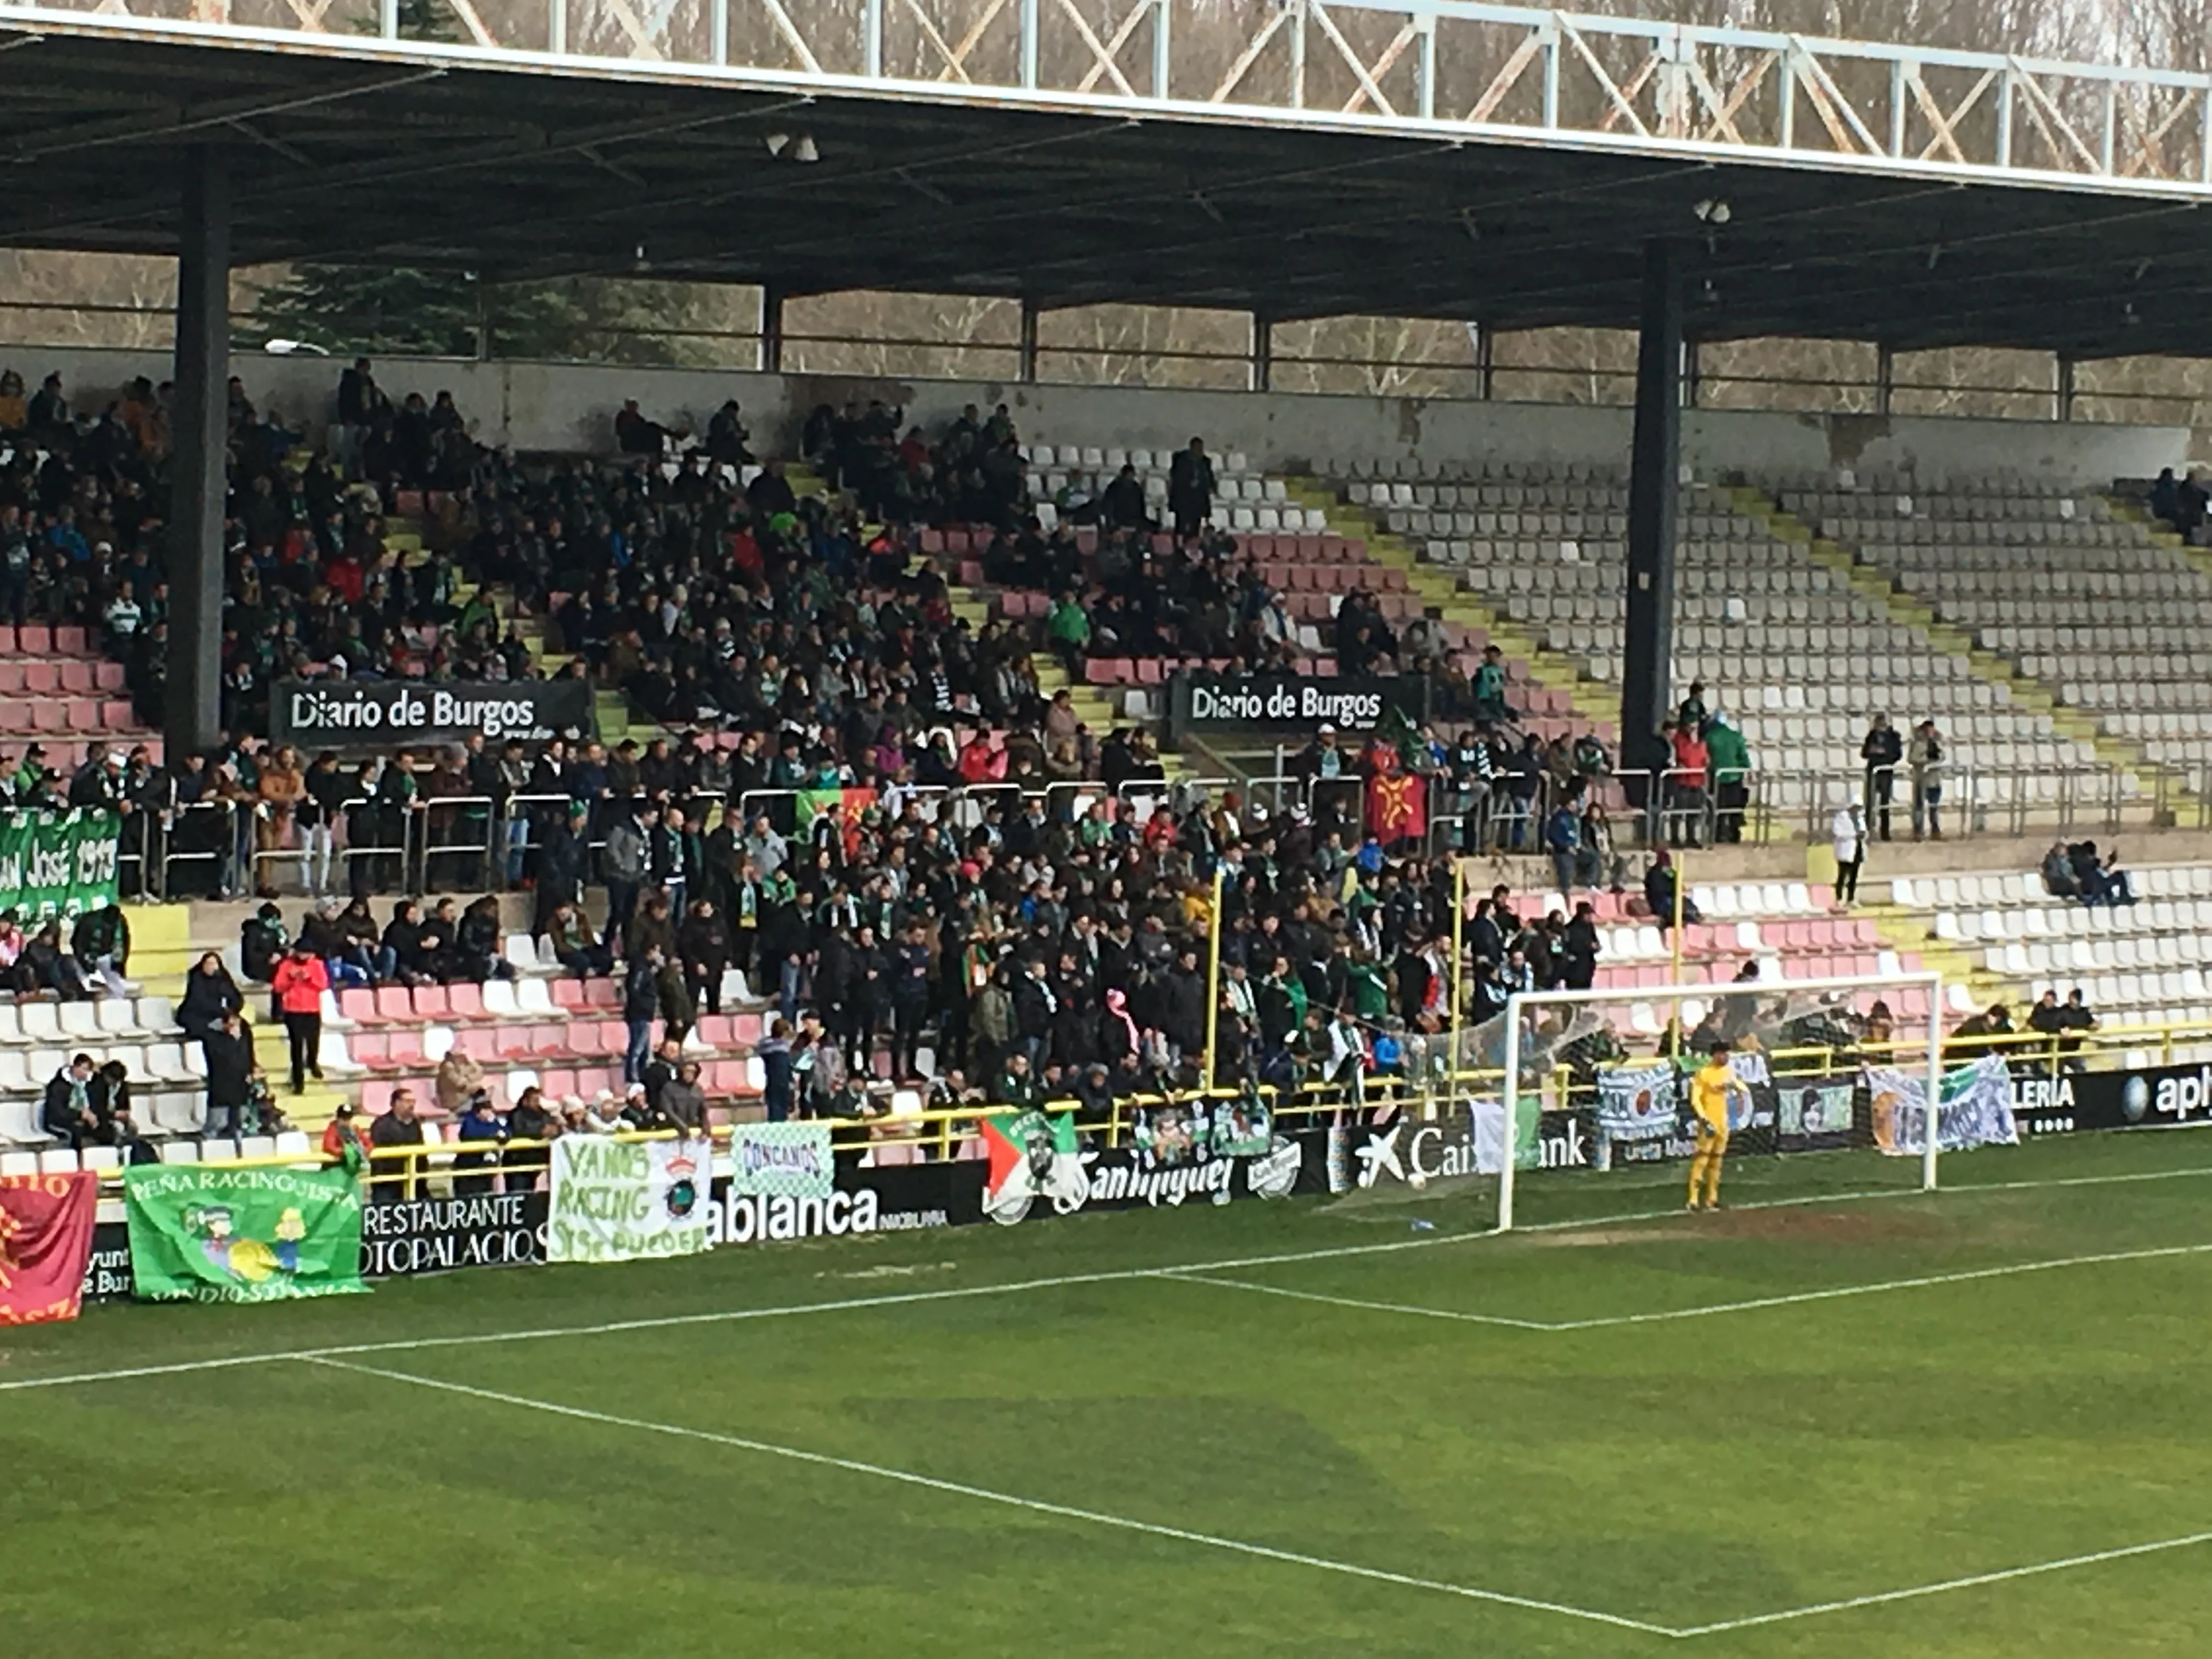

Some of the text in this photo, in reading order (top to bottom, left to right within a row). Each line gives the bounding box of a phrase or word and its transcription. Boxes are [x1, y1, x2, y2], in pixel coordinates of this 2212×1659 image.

[292, 691, 382, 727] Diario
[388, 690, 426, 726] de
[433, 691, 534, 736] Burgos
[1192, 684, 1381, 727] Diario de Burgos
[2010, 1078, 2075, 1109] LERIA
[131, 1173, 196, 1201] PEÑA
[556, 1180, 651, 1222] RACING
[363, 1195, 524, 1235] RESTAURANTE
[704, 1185, 878, 1244] ablanca
[360, 1222, 549, 1274] OTOPALACIOS
